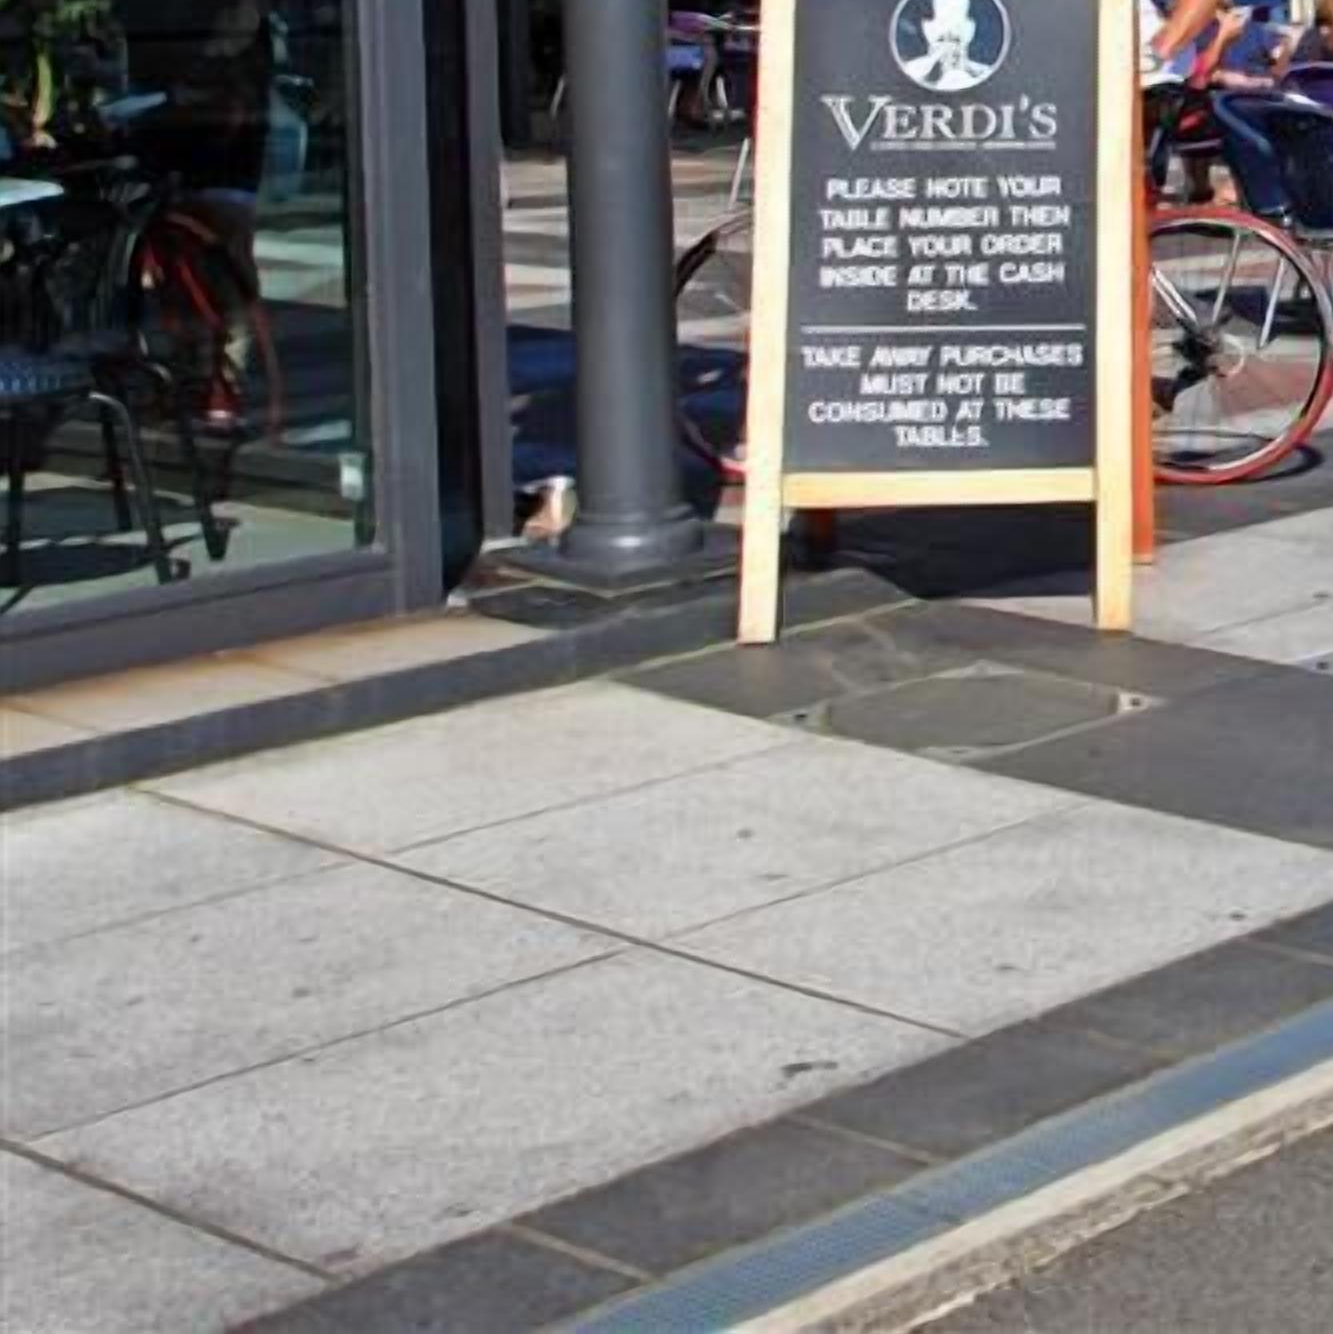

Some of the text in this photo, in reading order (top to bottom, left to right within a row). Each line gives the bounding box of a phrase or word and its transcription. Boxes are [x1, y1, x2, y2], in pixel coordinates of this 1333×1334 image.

[820, 93, 1058, 151] VERDI'S
[826, 174, 1062, 200] PLEASE NOTE YOUR
[820, 204, 1071, 230] TABLE NUMBER THEN
[822, 233, 1064, 259] PLACE YOUR ORDER
[819, 262, 1066, 288] INSIDE AT THE CASH
[906, 290, 979, 312] DESK.
[801, 344, 1084, 368] TAKE AWAY PURCHASES
[859, 372, 1026, 395] MUST NOT BE
[808, 397, 1071, 423] CONSUMED AT THESE
[895, 424, 990, 448] TABLES.
